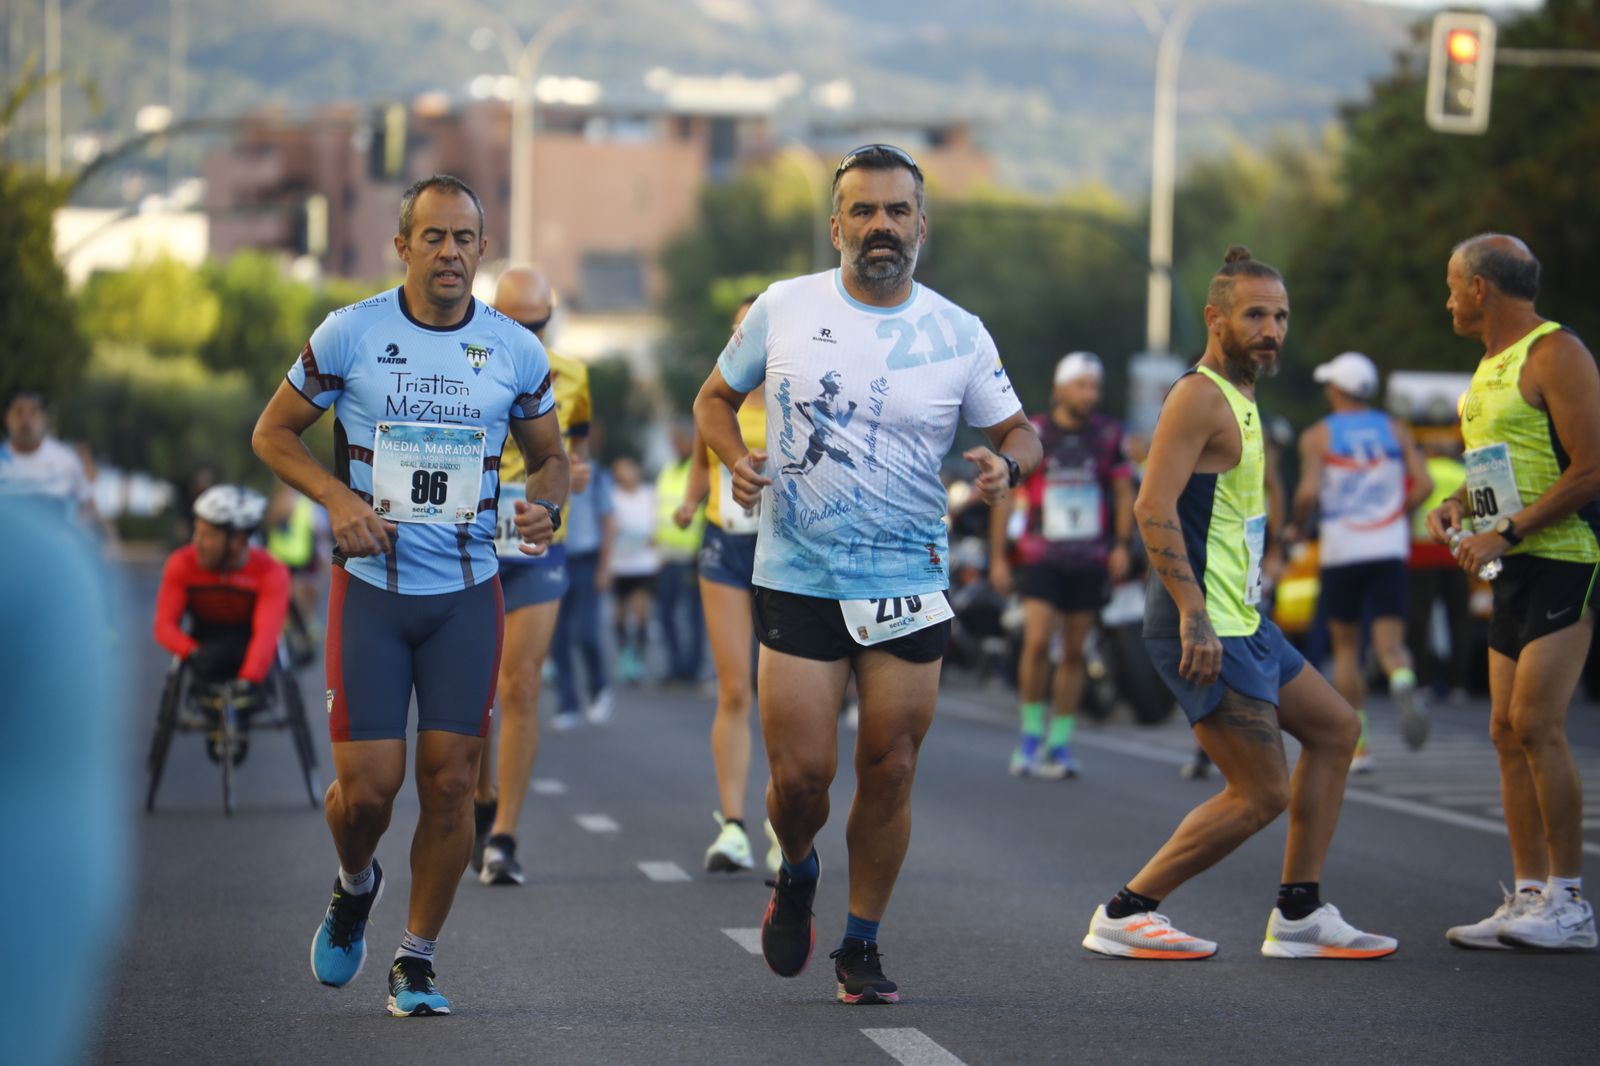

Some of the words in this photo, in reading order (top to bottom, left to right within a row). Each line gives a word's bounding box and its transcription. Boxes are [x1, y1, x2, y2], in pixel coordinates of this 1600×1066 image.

[377, 356, 408, 365] VIATOR
[389, 371, 470, 396] Triatlon
[869, 396, 884, 417] del
[380, 440, 420, 453] MEDIA
[425, 442, 480, 455] MARATÓN
[411, 469, 448, 506] 96
